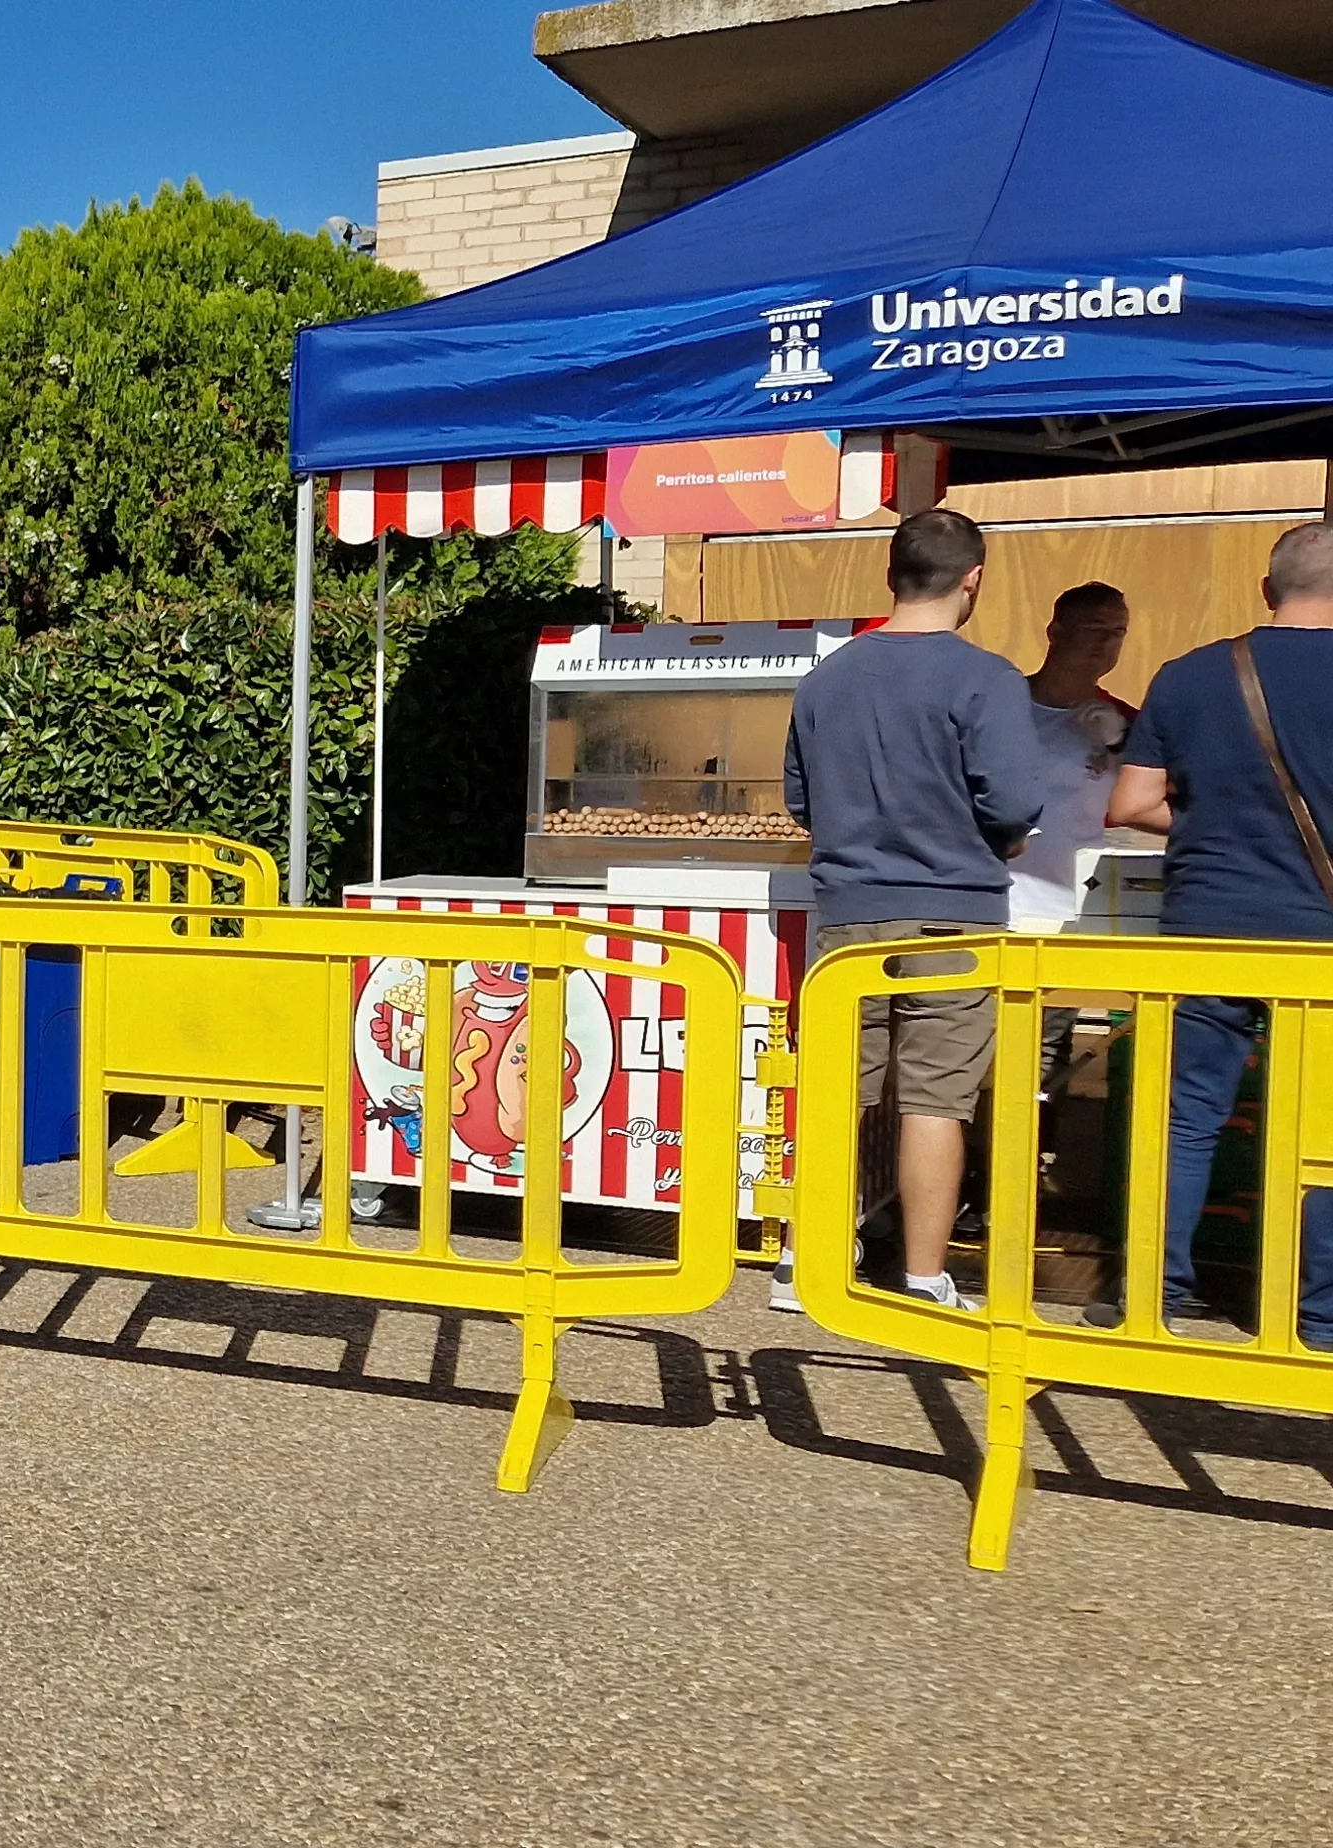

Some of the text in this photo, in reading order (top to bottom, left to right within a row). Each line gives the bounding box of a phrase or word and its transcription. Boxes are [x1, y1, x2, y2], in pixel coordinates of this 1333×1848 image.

[870, 274, 1183, 333] Universidad
[871, 333, 1066, 371] Zaragoza
[770, 389, 813, 403] 1474
[656, 468, 787, 487] Perritos calientes
[556, 657, 655, 672] AMERICAN
[666, 655, 750, 670] CLASSIC
[760, 654, 799, 668] HOT
